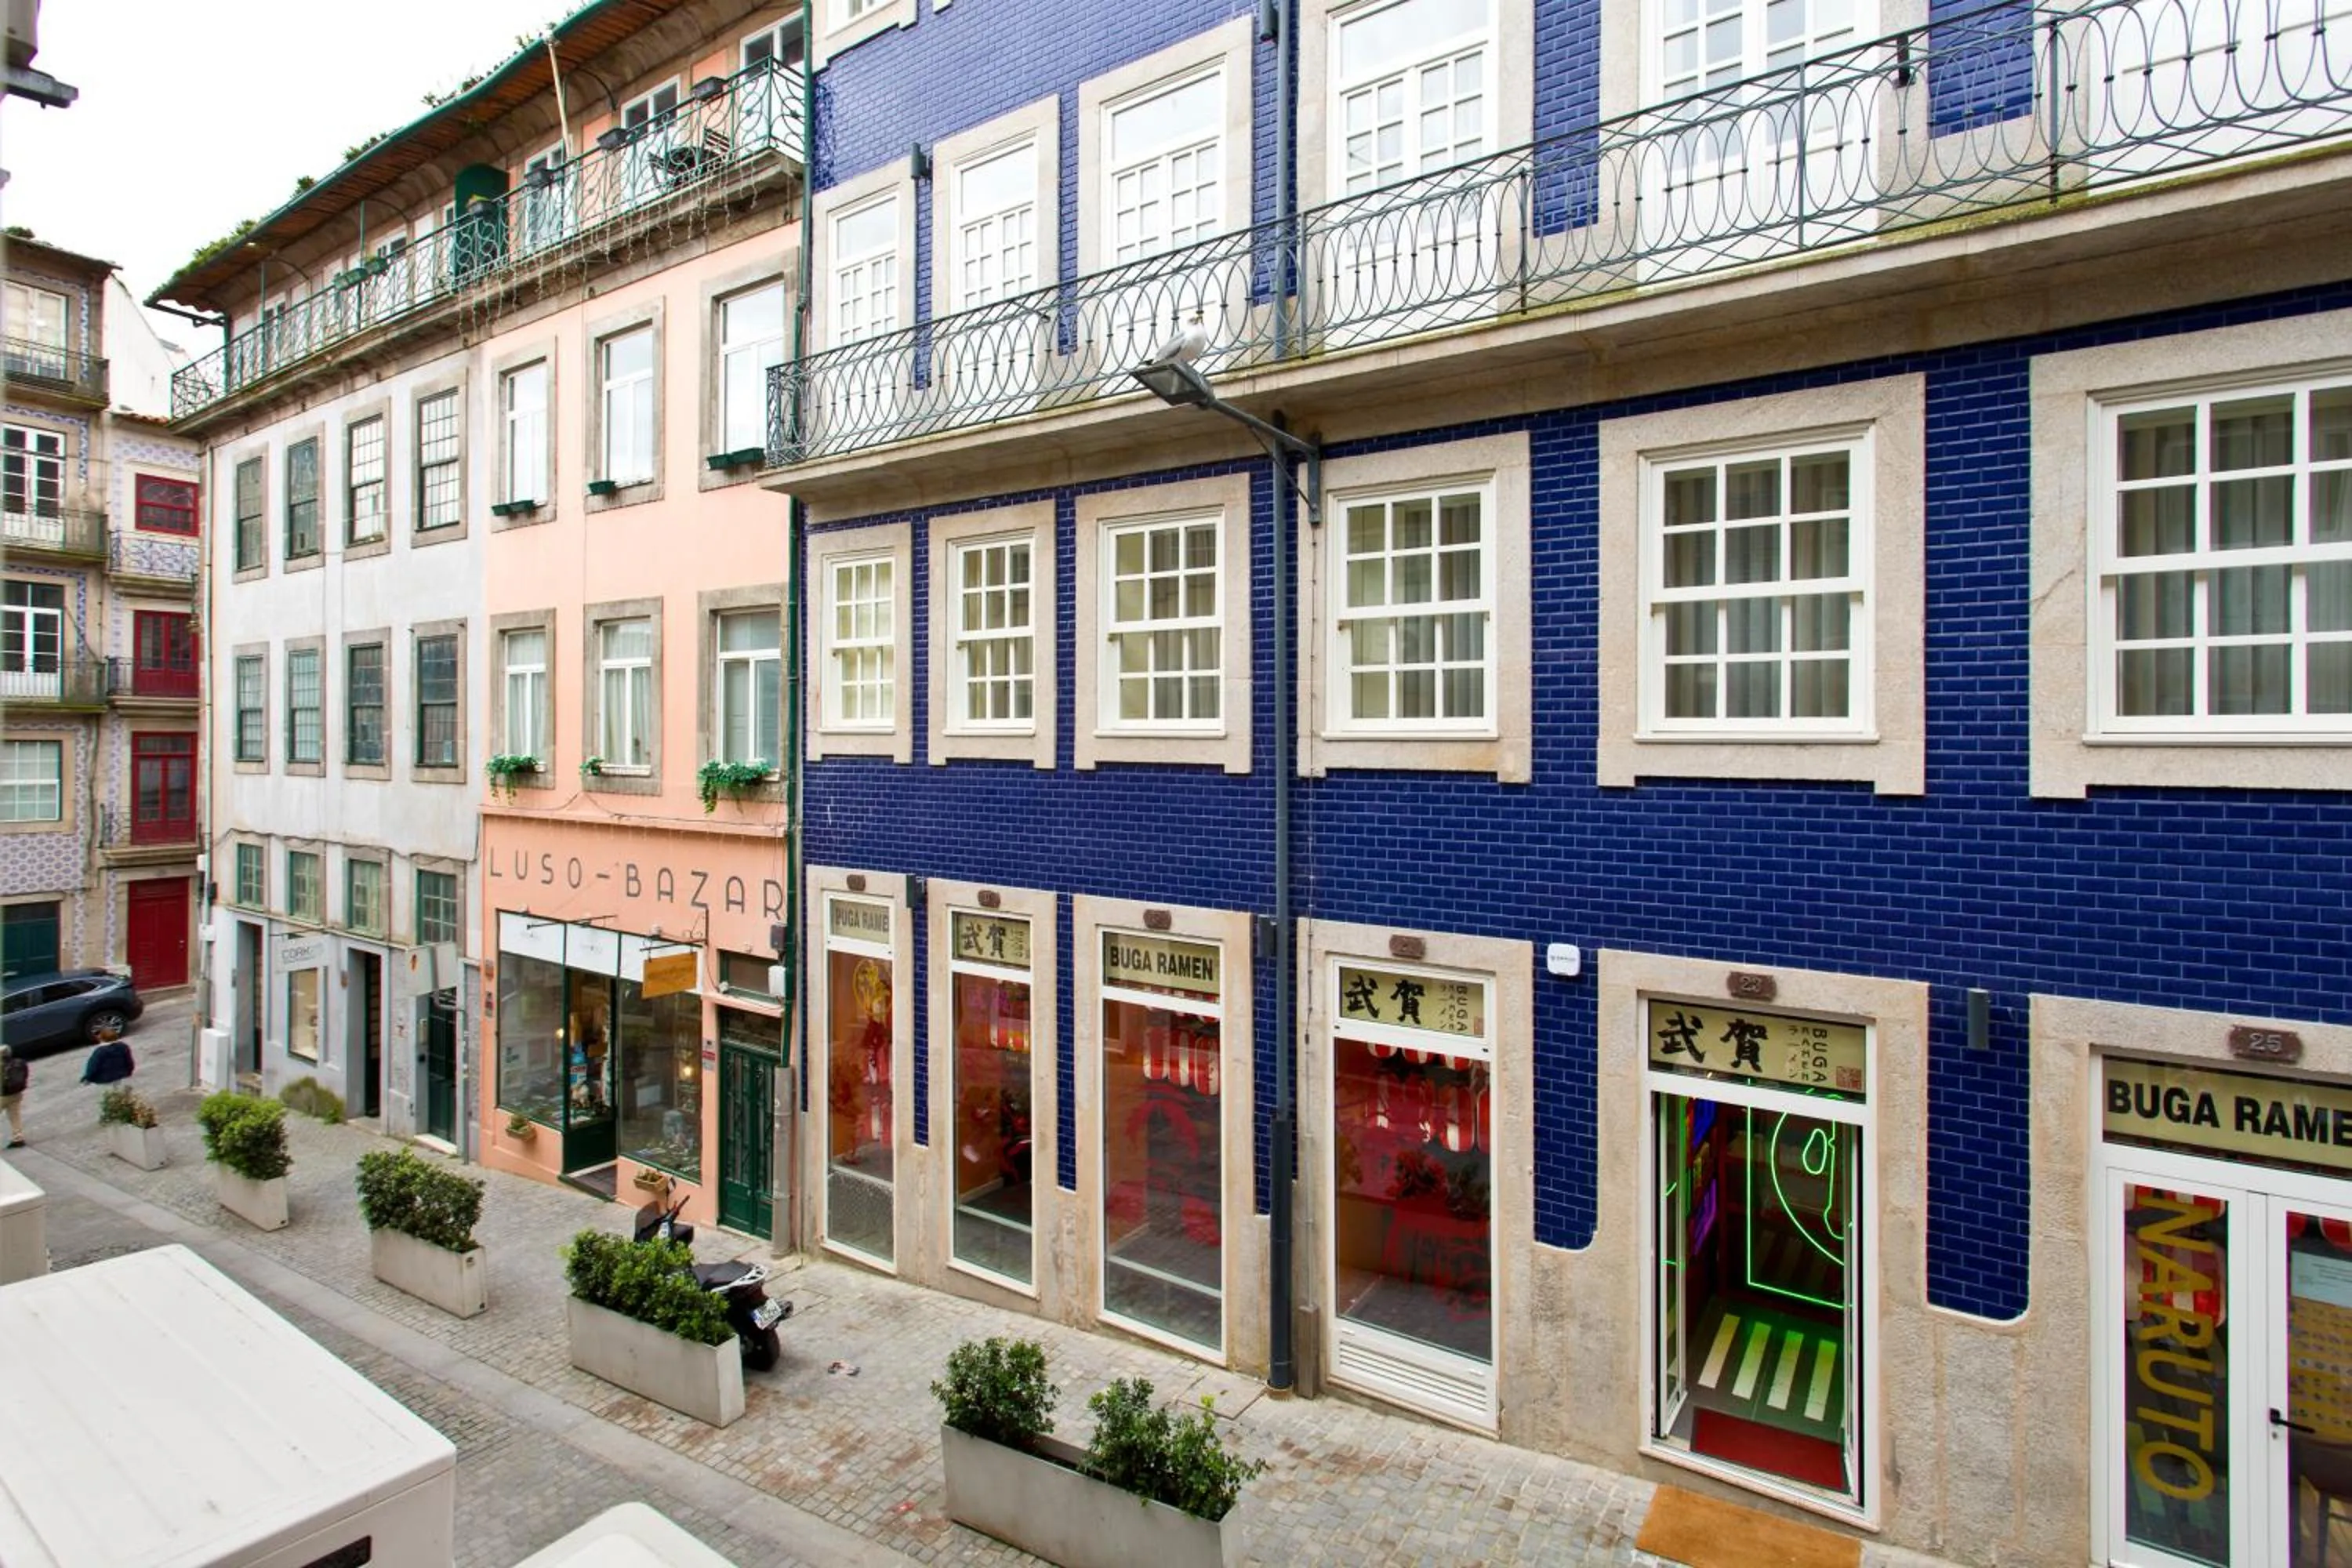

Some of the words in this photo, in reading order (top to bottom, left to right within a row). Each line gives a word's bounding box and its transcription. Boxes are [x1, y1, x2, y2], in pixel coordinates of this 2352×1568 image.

[1109, 946, 1152, 972] BUGA
[1156, 951, 1214, 981] RAMEN
[1456, 985, 1468, 1031] BUGA
[1812, 1027, 1828, 1082] BUGA
[2249, 1033, 2283, 1053] 25
[2107, 1078, 2221, 1129] BUGA
[2136, 1196, 2215, 1501] NARUTO
